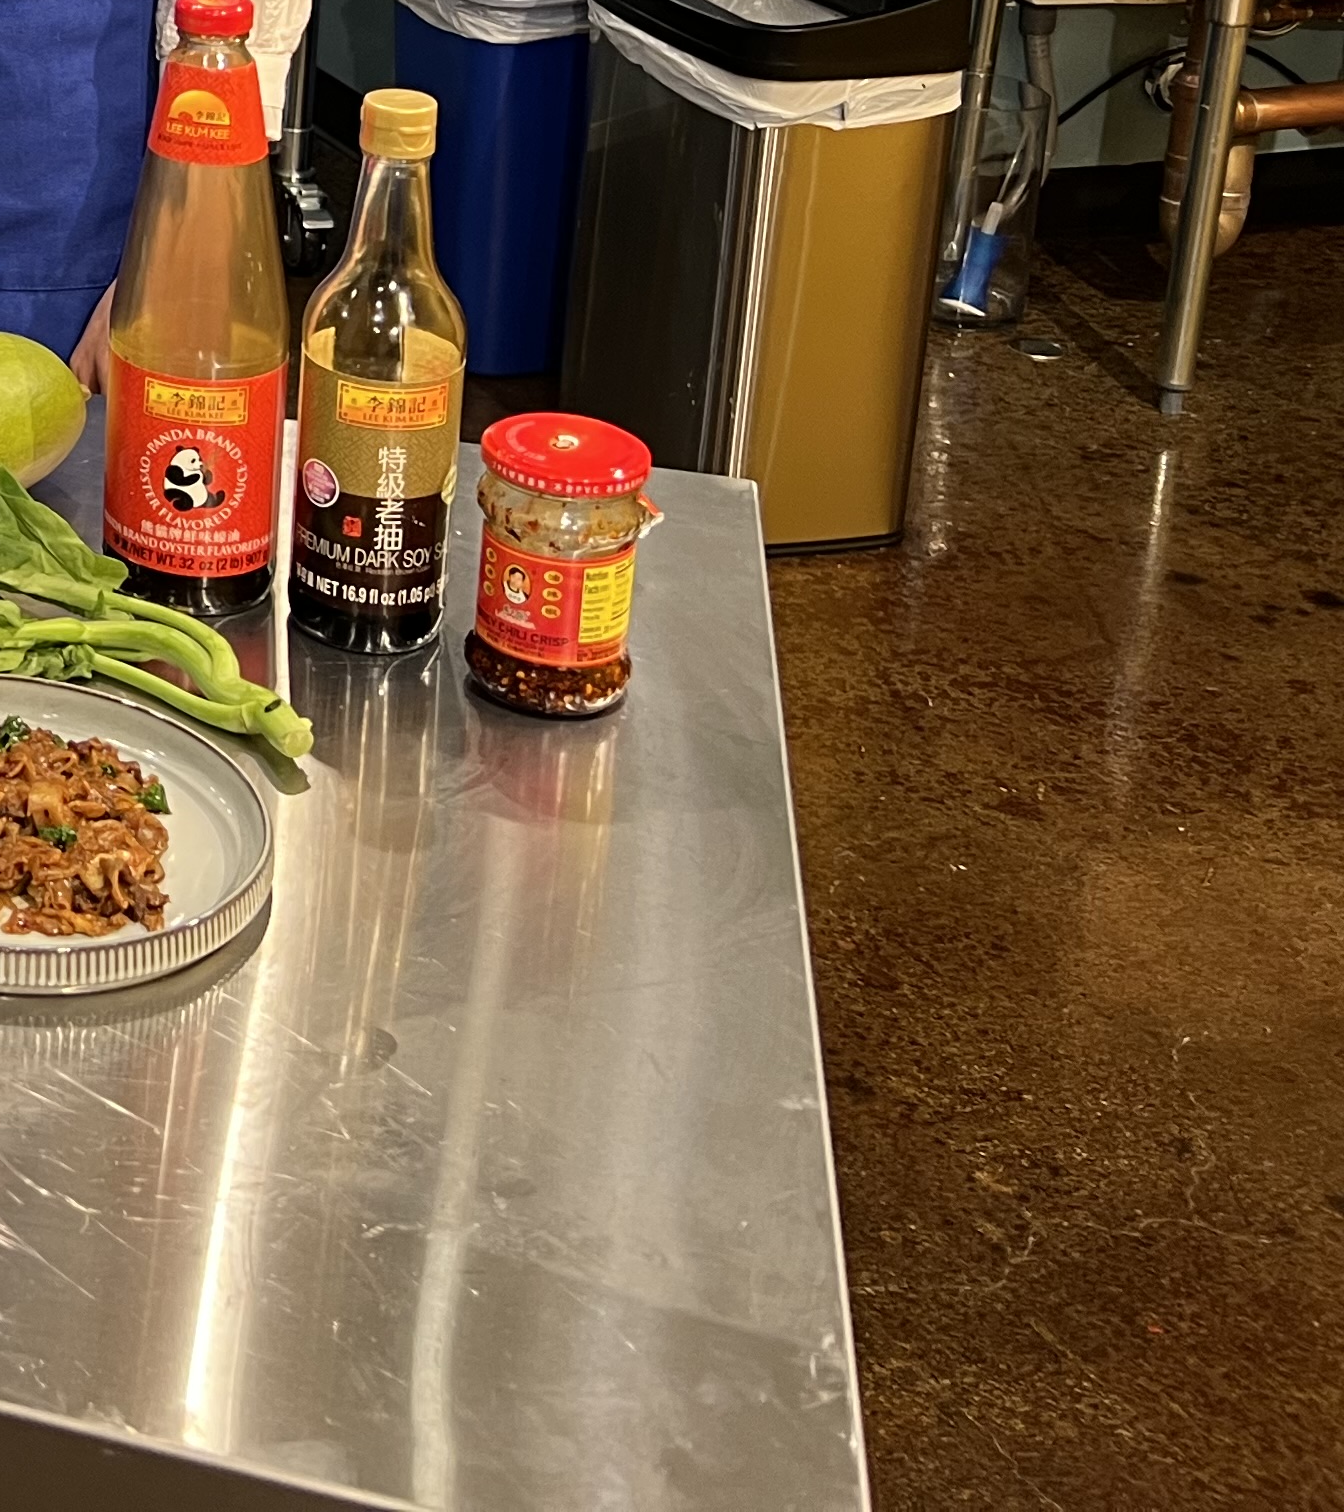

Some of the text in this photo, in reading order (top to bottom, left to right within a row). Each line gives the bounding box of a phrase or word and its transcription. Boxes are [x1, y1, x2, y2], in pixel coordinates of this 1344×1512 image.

[166, 121, 231, 140] LEE KUM KEE
[166, 407, 224, 419] LEE KUM KEE
[362, 413, 425, 423] LEE KUM KEE
[146, 428, 242, 460] PANDA BRAND
[139, 456, 161, 510] OYSTER
[158, 507, 232, 531] FLAVORED
[228, 463, 248, 508] SAUCE
[372, 446, 407, 551] 特級老抽
[123, 525, 158, 549] BRAND
[159, 539, 207, 556] OYSTER
[207, 538, 261, 557] FLAVORED
[156, 551, 177, 569] WT.
[178, 557, 195, 571] 32
[199, 560, 213, 571] oz
[216, 558, 229, 573] (2
[354, 547, 399, 569] DARK
[402, 545, 433, 568] SOY
[316, 575, 340, 597] NET
[342, 584, 367, 605] 16.9
[369, 588, 379, 605] fl
[380, 591, 396, 606] oz
[397, 586, 423, 607] (1.05
[498, 621, 528, 641] CHILI
[530, 633, 569, 647] CRISP
